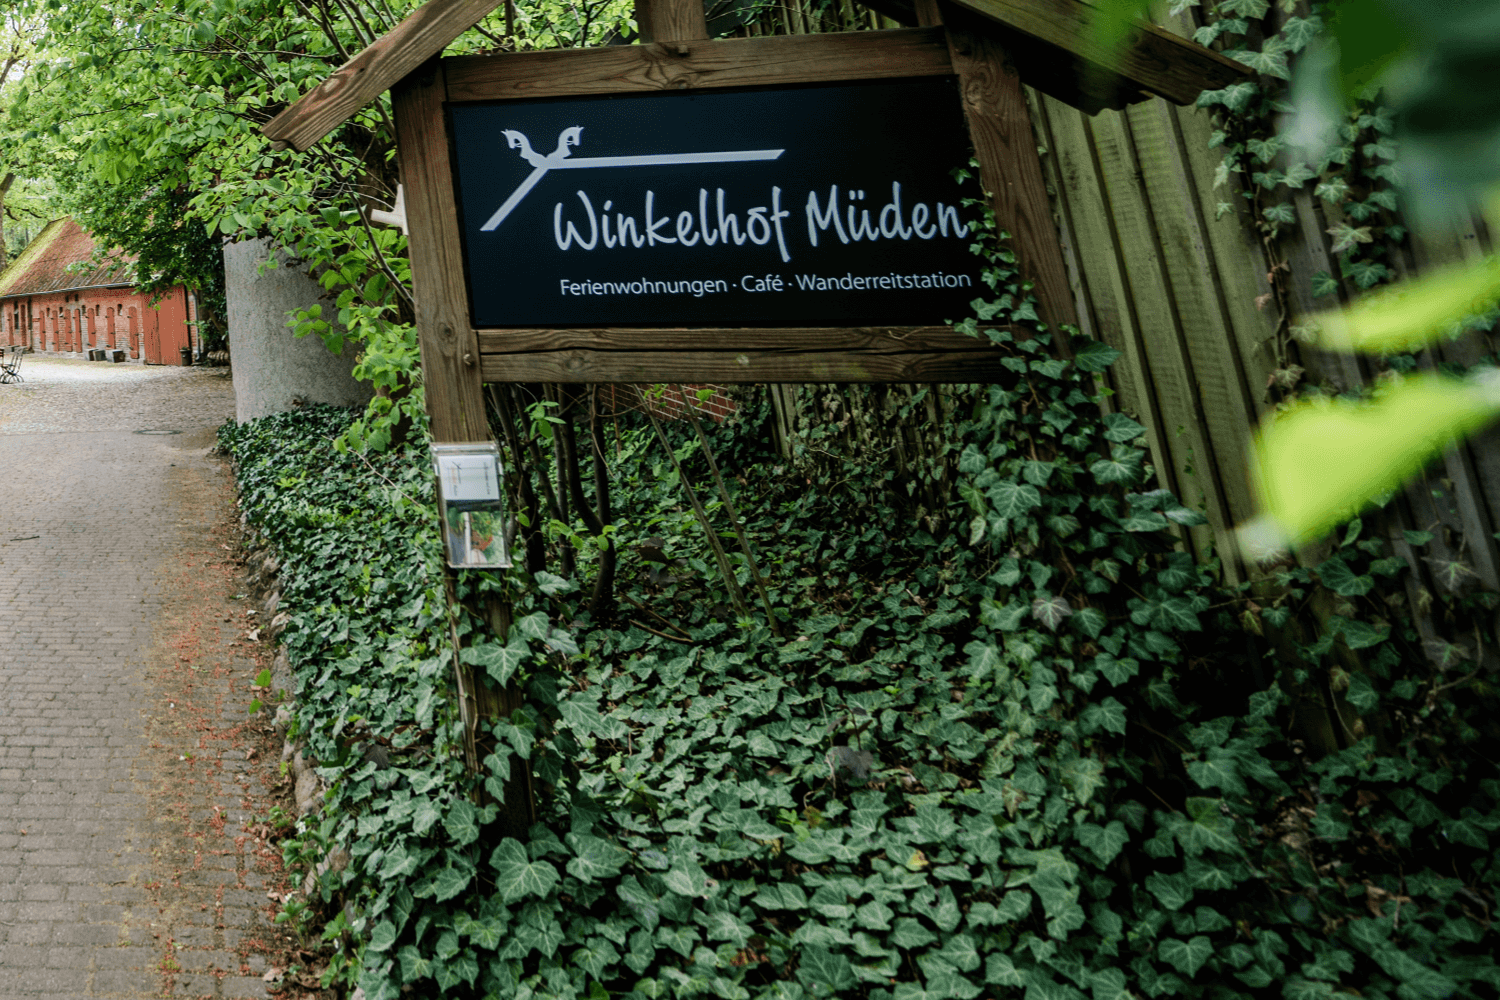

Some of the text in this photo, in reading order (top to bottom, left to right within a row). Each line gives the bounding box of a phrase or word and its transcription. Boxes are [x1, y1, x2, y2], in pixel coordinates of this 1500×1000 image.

[553, 180, 969, 263] Winkelhof Müden
[560, 271, 972, 298] Ferienwohnungen Café Wanderreitstation
